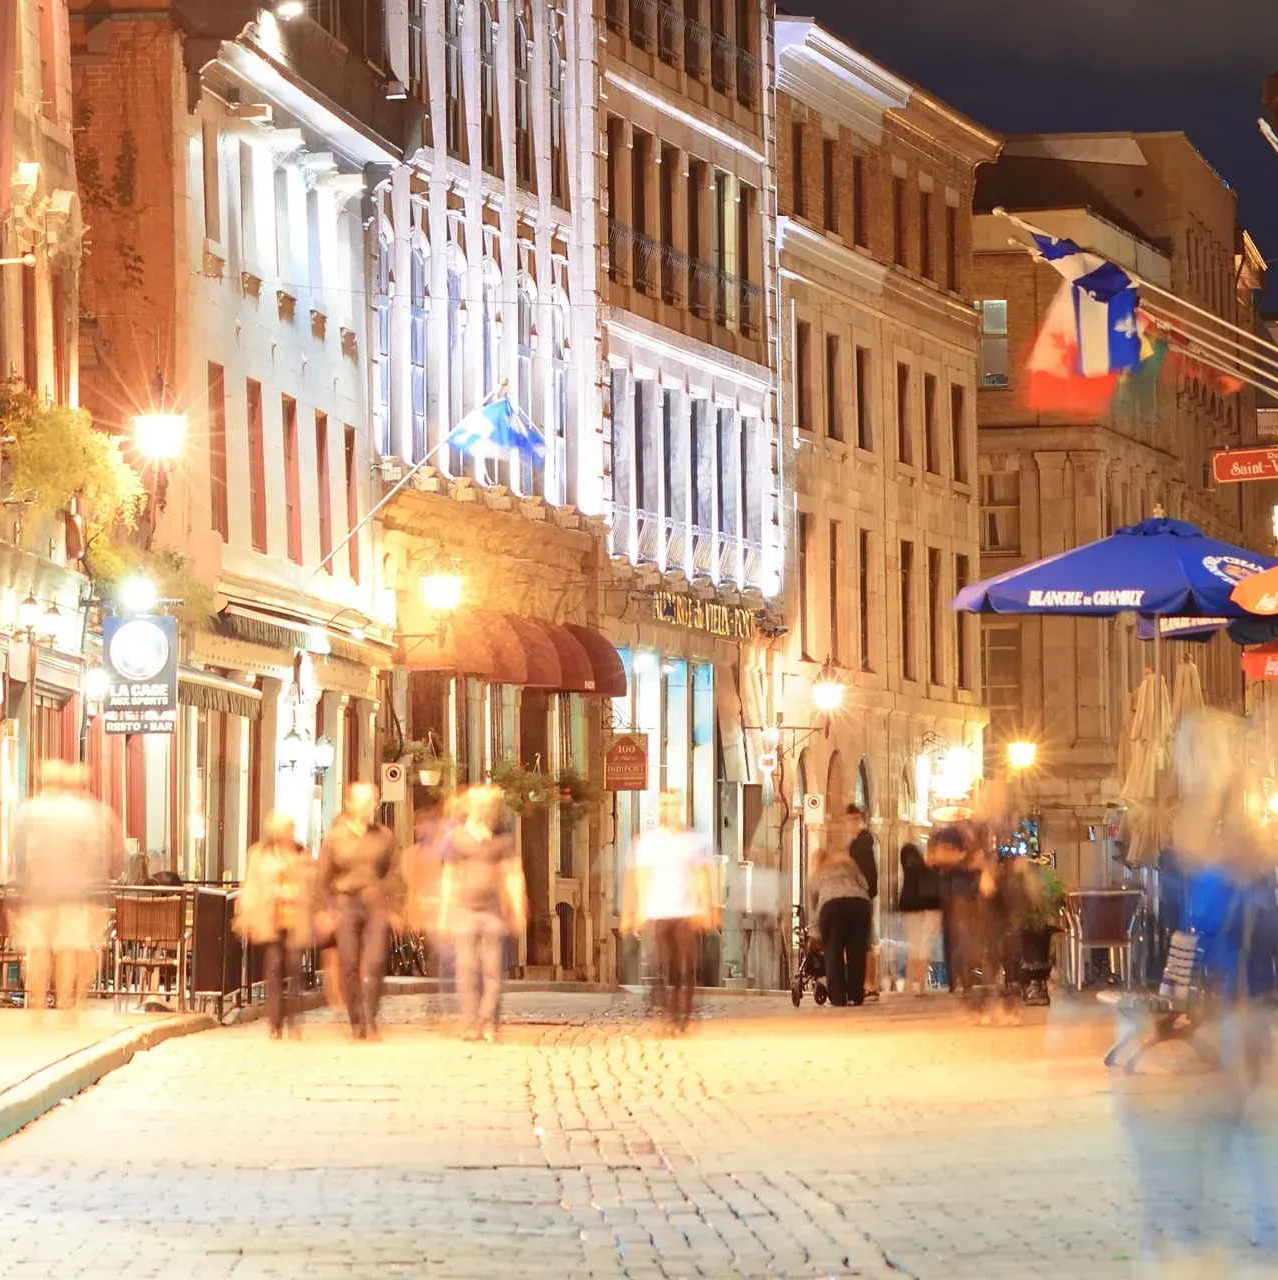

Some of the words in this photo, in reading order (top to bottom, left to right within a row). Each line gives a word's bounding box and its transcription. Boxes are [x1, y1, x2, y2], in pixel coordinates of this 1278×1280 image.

[1027, 590, 1084, 607] BLANCHE
[1093, 590, 1145, 607] CHAMBLY
[109, 684, 130, 697] LA
[131, 684, 169, 697] CAGE
[109, 696, 130, 706] AUX
[131, 696, 169, 706] SPORTS
[107, 721, 142, 732] RESTO
[149, 721, 173, 732] BAR
[617, 745, 636, 754] 100
[607, 765, 644, 773] INDIPORT
